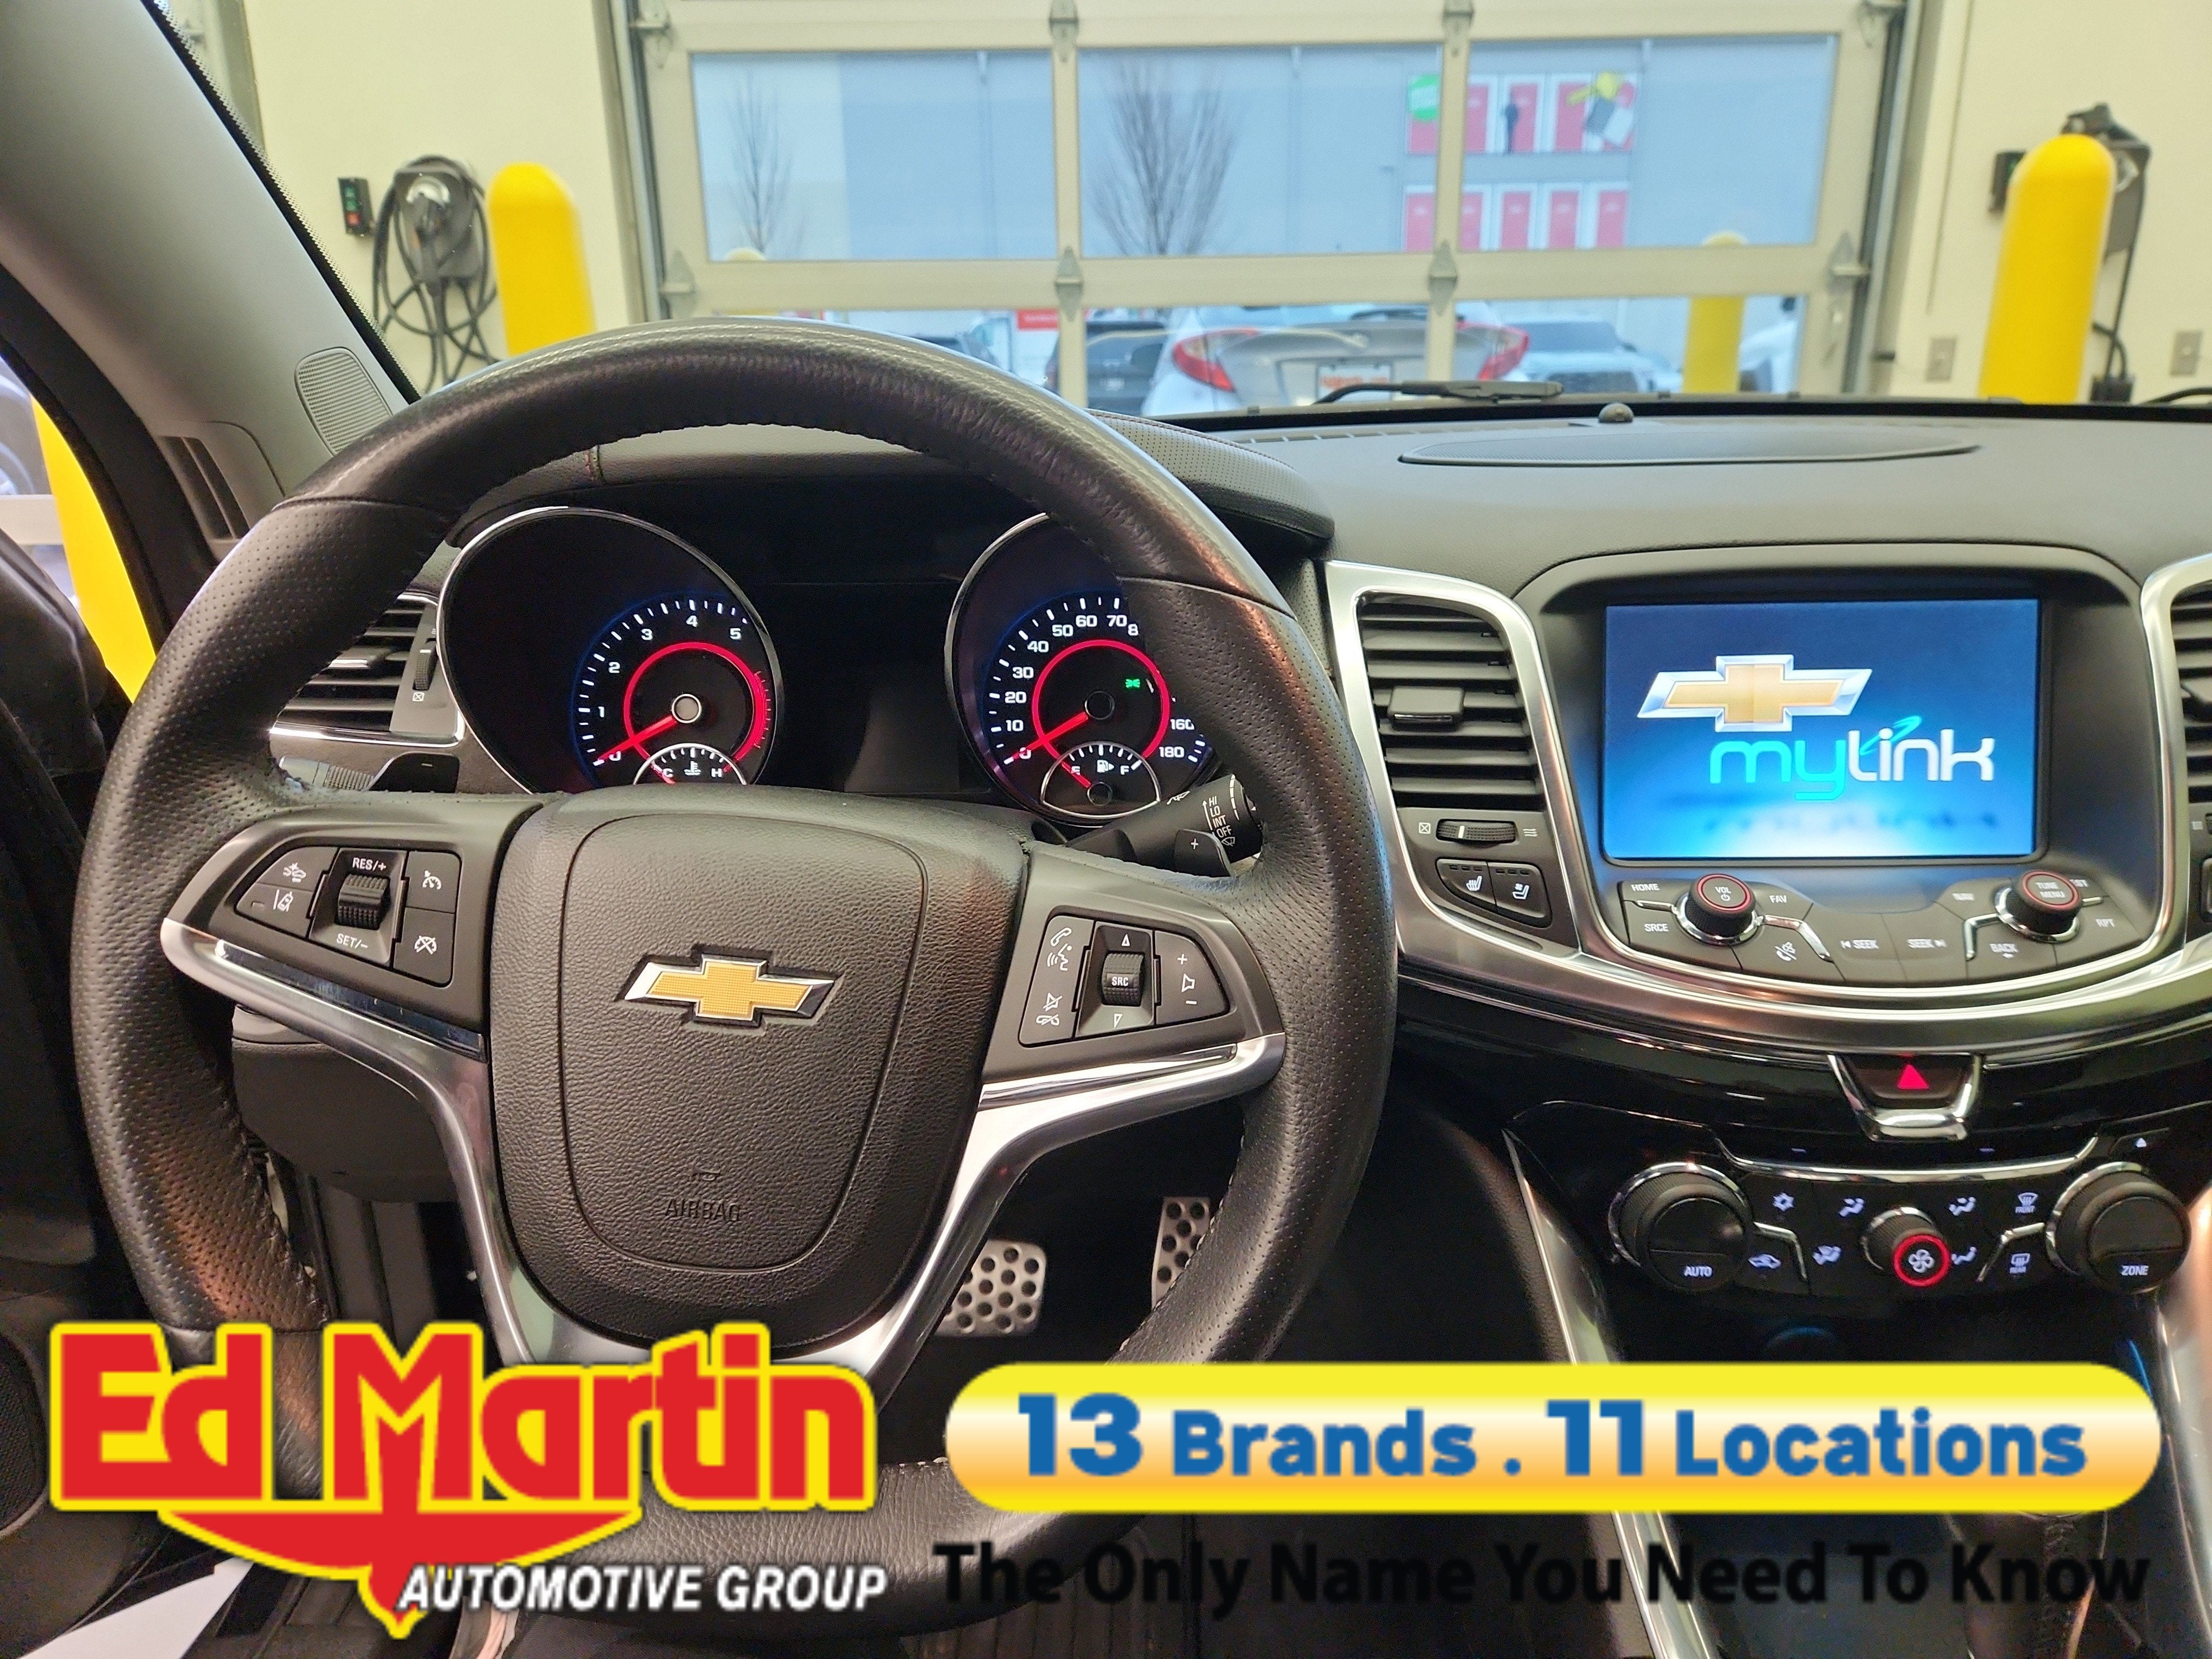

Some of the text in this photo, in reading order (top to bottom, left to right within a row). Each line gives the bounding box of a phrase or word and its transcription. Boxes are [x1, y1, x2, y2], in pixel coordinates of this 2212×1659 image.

[686, 615, 698, 627] 4
[1076, 615, 1097, 627] 60
[1107, 615, 1127, 628] 70
[641, 629, 653, 640] 3
[730, 628, 741, 639] 5
[1052, 625, 1073, 637] 50
[1128, 623, 1139, 636] 8
[1027, 640, 1049, 653] 40
[609, 662, 620, 673] 2
[1012, 667, 1033, 679] 30
[1005, 692, 1026, 704] 20
[598, 706, 605, 718] 1
[1006, 719, 1024, 731] 10
[1170, 718, 1195, 730] 160
[1159, 746, 1185, 758] 180
[663, 768, 673, 777] C
[711, 768, 723, 777] H
[1120, 765, 1129, 775] F
[1208, 795, 1217, 807] HI
[1210, 806, 1220, 817] LO
[1212, 815, 1226, 828] INT
[1216, 825, 1232, 838] OFF
[1631, 883, 1660, 892] HOME
[1715, 886, 1732, 895] VOL
[1770, 895, 1787, 904] FAV
[1644, 923, 1669, 933] SRCE
[2095, 918, 2115, 928] RPT
[1853, 939, 1879, 949] SEEK
[1907, 938, 1934, 949] SEEK
[1989, 943, 2018, 953] BACK
[1111, 976, 1129, 987] SRC
[665, 1198, 740, 1221] AIRBAG
[1684, 1265, 1712, 1278] AUTO
[2121, 1265, 2149, 1276] ZONE
